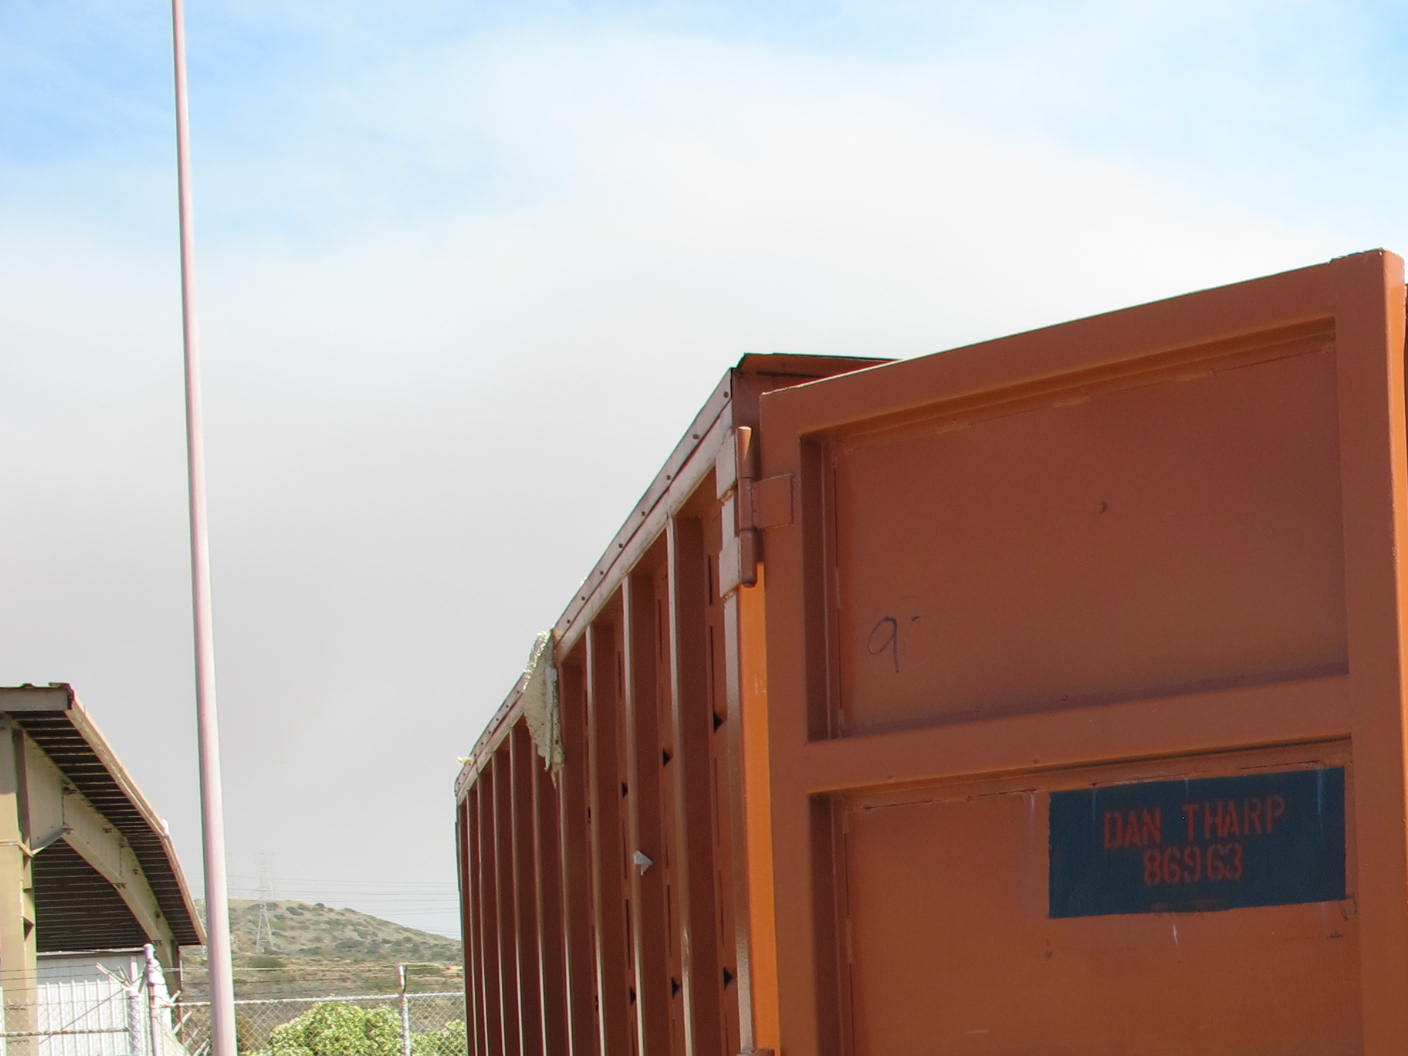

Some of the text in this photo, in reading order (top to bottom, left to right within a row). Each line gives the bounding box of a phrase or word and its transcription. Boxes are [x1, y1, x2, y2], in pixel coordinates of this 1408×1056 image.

[1103, 795, 1287, 849] DAN THARP
[1143, 843, 1244, 886] 86963
